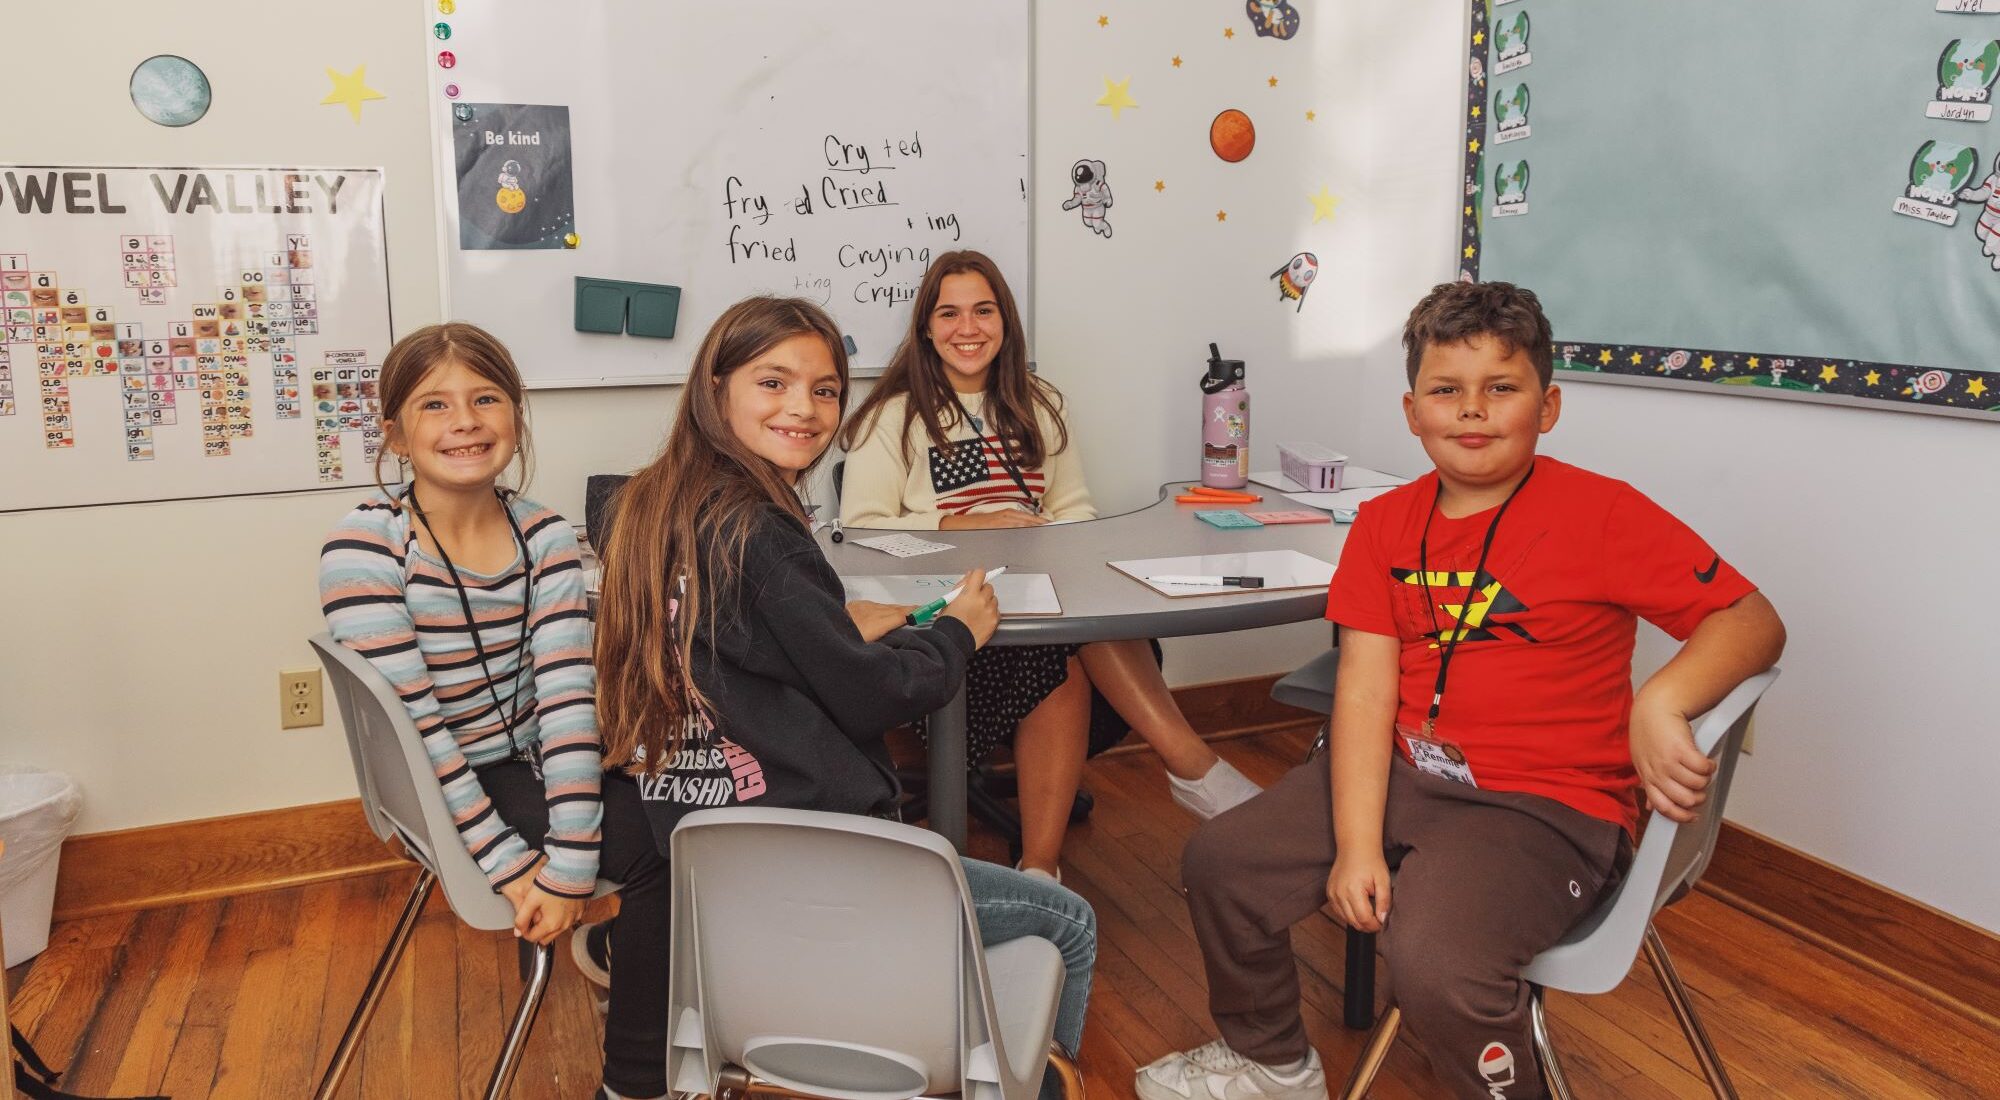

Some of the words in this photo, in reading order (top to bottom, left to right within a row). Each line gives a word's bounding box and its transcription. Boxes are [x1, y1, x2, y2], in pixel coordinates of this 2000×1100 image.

[1941, 104, 1975, 120] Jordyn
[485, 130, 505, 146] Be
[508, 130, 541, 146] kind
[824, 135, 870, 176] Cry
[0, 171, 127, 214] WEL
[149, 173, 346, 215] VALLEY
[723, 176, 770, 226] fry
[821, 176, 888, 210] Cried
[1925, 207, 1952, 222] Taylor
[925, 212, 961, 242] ing
[725, 224, 797, 264] fried
[838, 244, 930, 278] Crying
[194, 307, 216, 317] aw
[314, 370, 333, 381] er
[338, 369, 356, 380] ar
[361, 368, 380, 379] or
